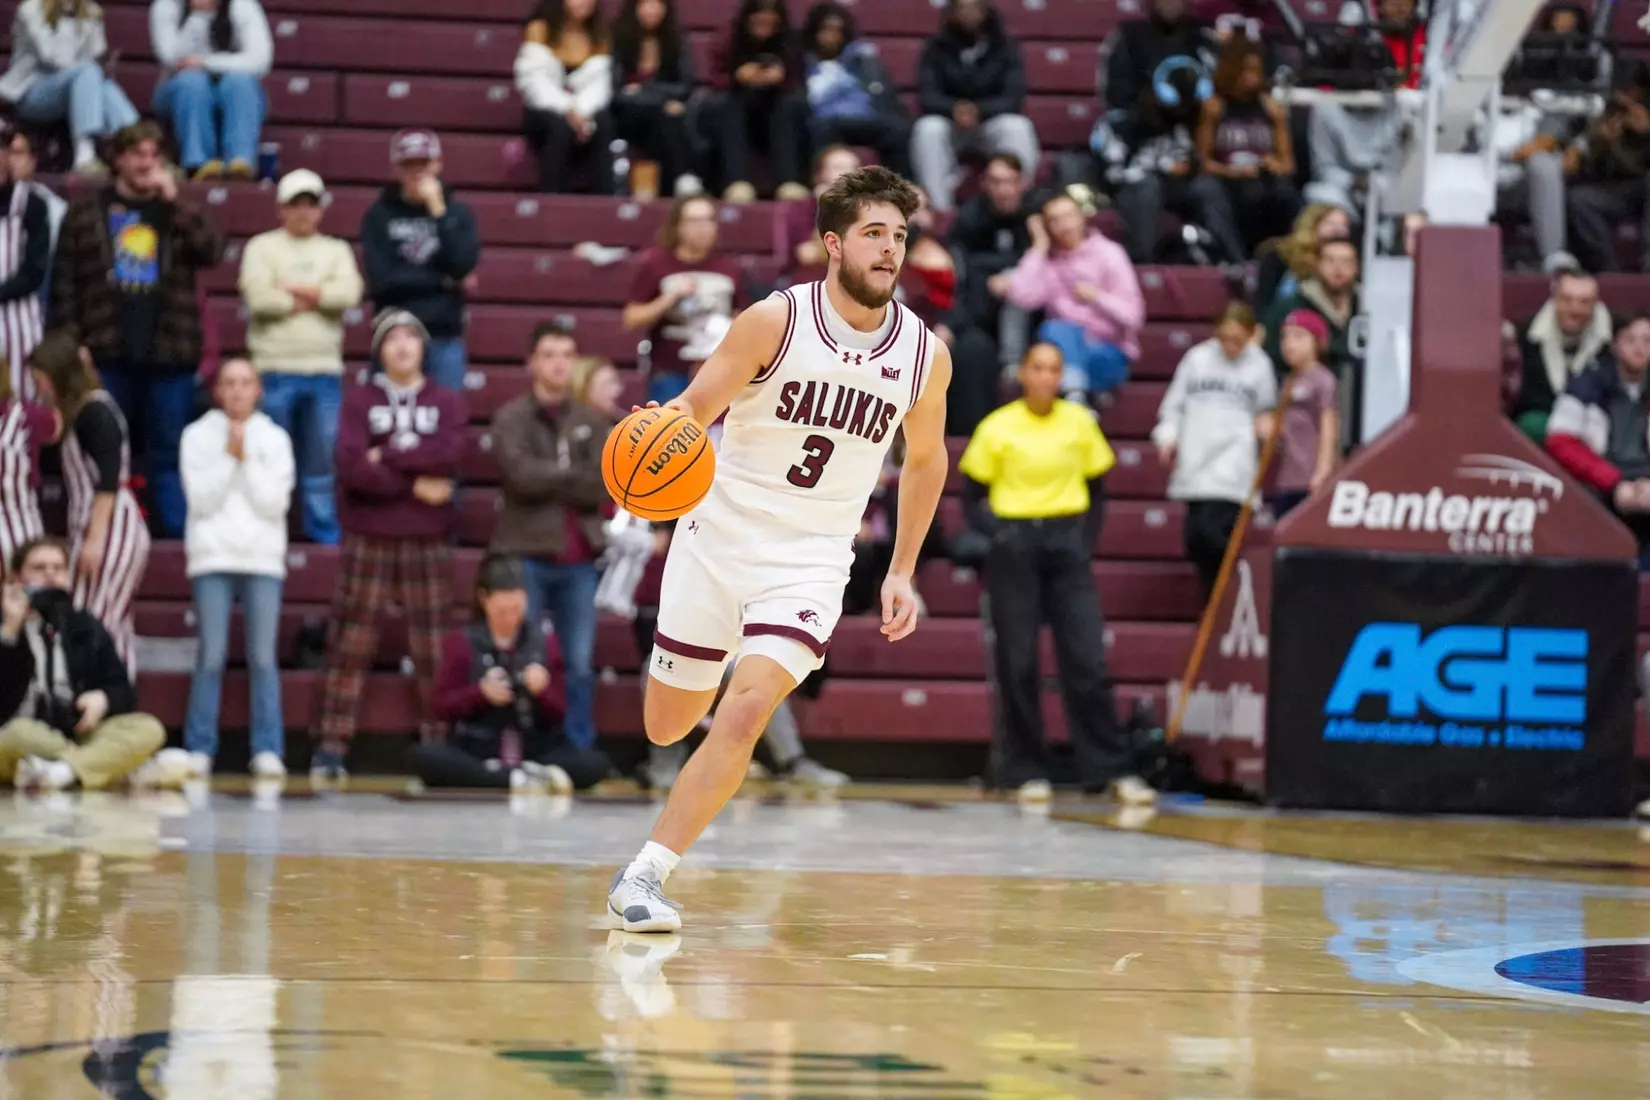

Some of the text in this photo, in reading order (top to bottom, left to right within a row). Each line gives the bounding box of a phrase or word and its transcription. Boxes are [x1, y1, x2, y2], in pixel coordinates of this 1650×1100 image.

[775, 380, 897, 444] SALUKIS
[645, 421, 703, 476] Wilson
[786, 434, 835, 489] 3
[1327, 480, 1537, 533] Banterra
[1448, 532, 1534, 555] CENTER
[1323, 620, 1589, 722] AGE
[1322, 718, 1436, 745] Affordable
